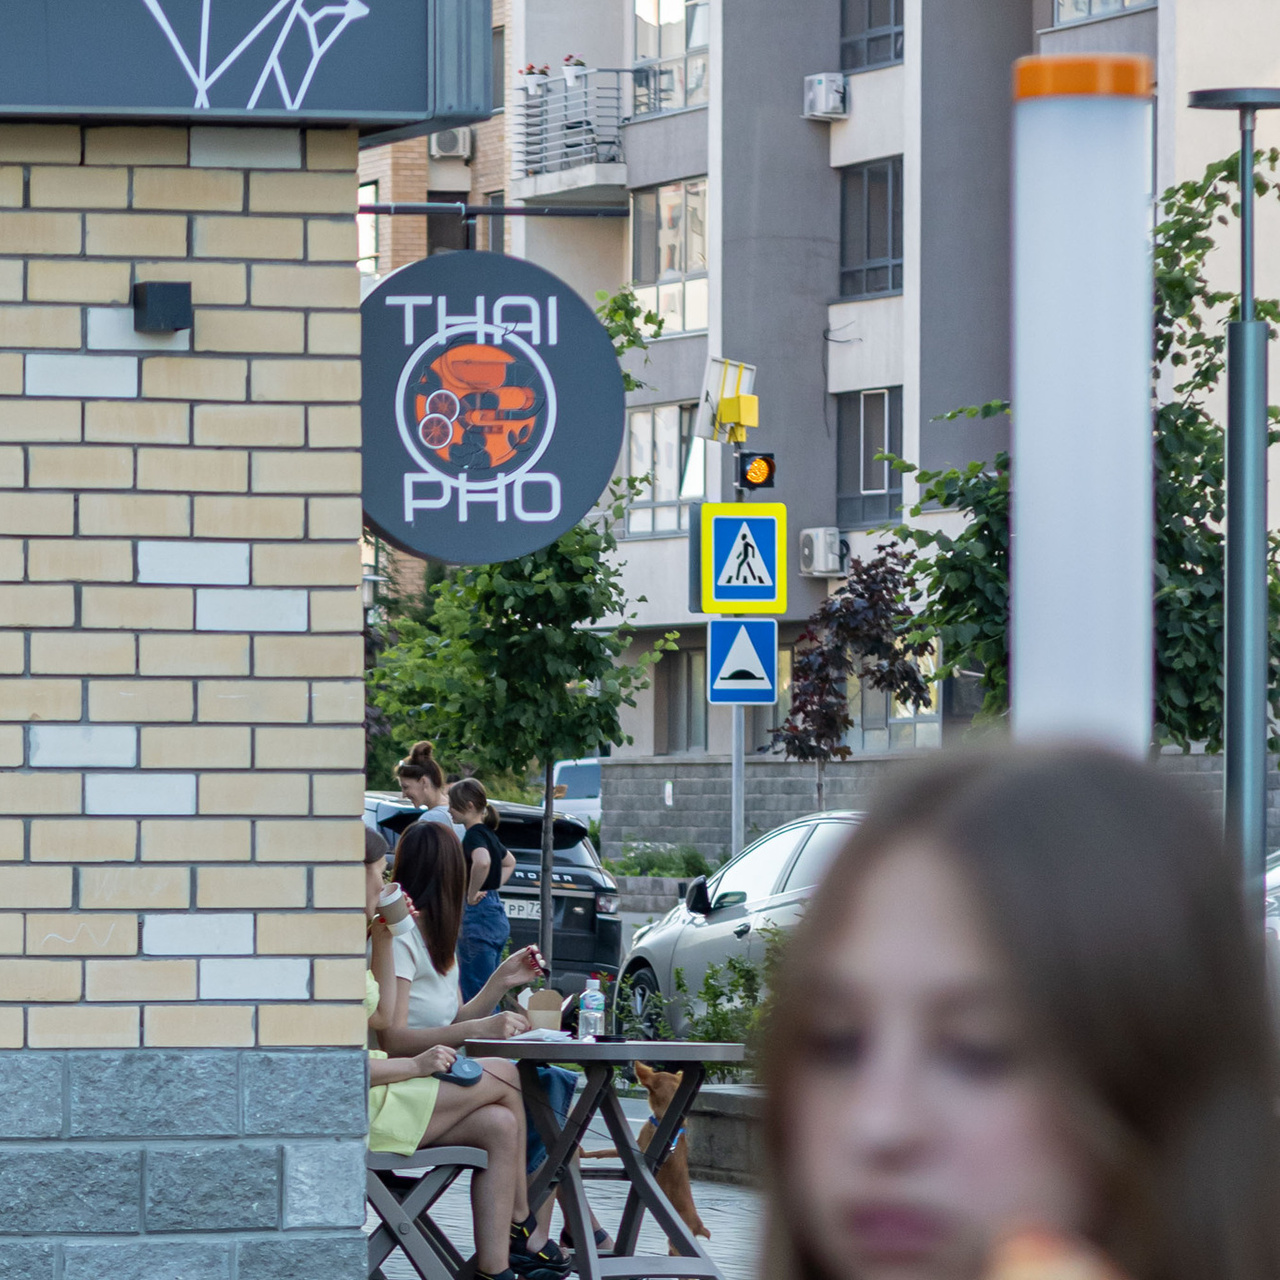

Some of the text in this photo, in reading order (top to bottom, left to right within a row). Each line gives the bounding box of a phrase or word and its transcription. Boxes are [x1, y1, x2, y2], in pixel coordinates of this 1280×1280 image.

[385, 295, 558, 345] THAI
[404, 472, 562, 523] PHO
[514, 871, 573, 882] ROER
